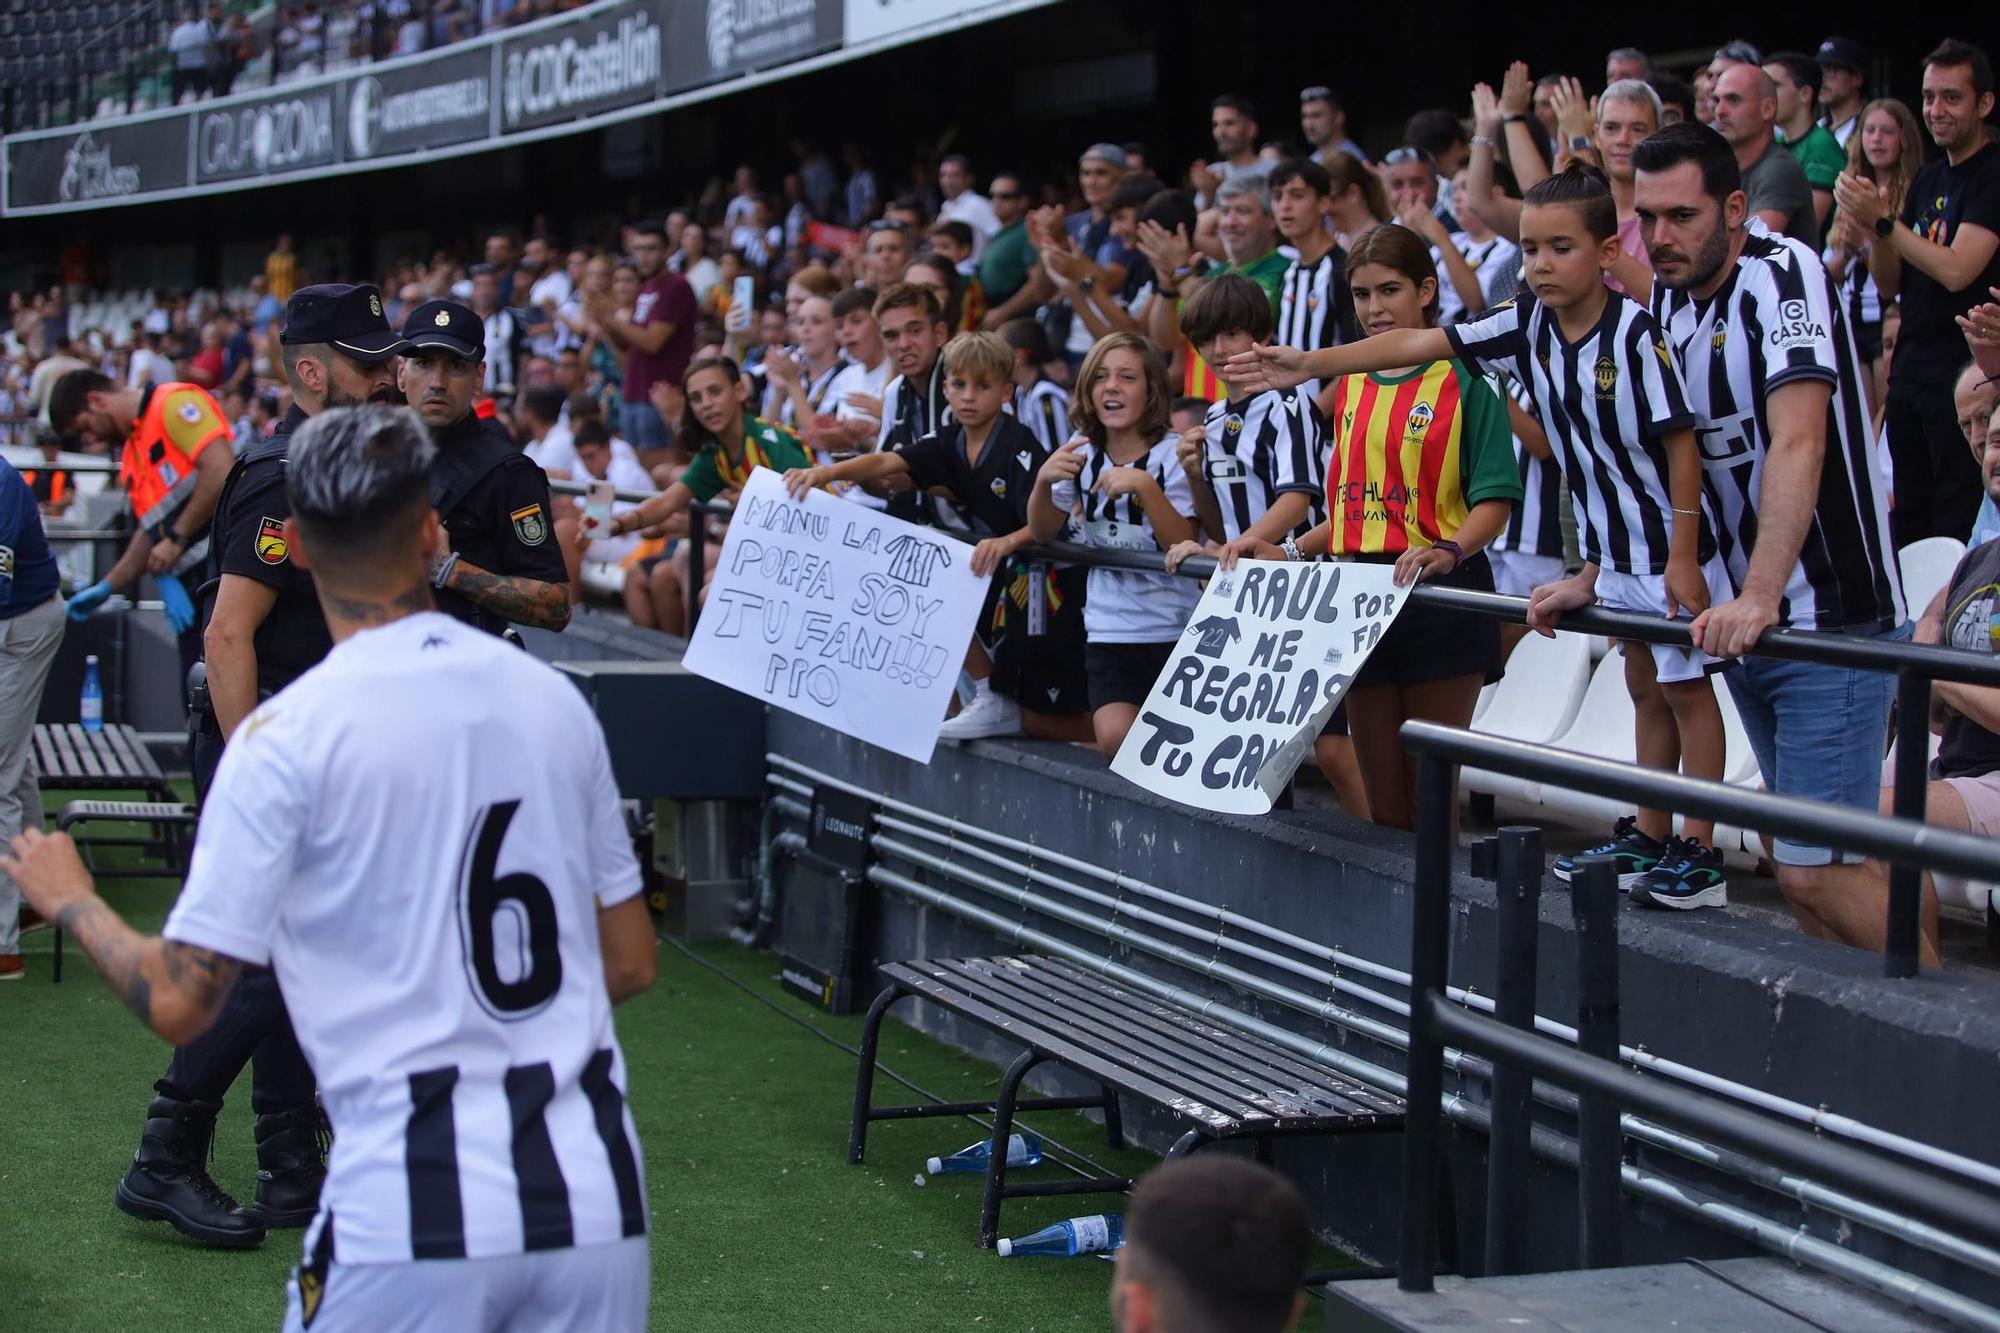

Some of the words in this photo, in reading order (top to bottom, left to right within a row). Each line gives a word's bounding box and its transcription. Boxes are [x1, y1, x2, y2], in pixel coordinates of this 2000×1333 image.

[1770, 321, 1827, 346] CASVA
[1781, 338, 1815, 350] Seguridad
[744, 496, 829, 541] MANU
[842, 522, 880, 554] LA
[714, 588, 789, 644] TU
[731, 540, 834, 600] PORFA
[852, 572, 943, 638] SOY
[1234, 562, 1341, 623] RAÚL
[1352, 592, 1395, 619] POR
[1201, 627, 1224, 648] 22
[1248, 629, 1303, 672] ME
[1351, 622, 1381, 654] FA
[456, 798, 564, 1022] 6
